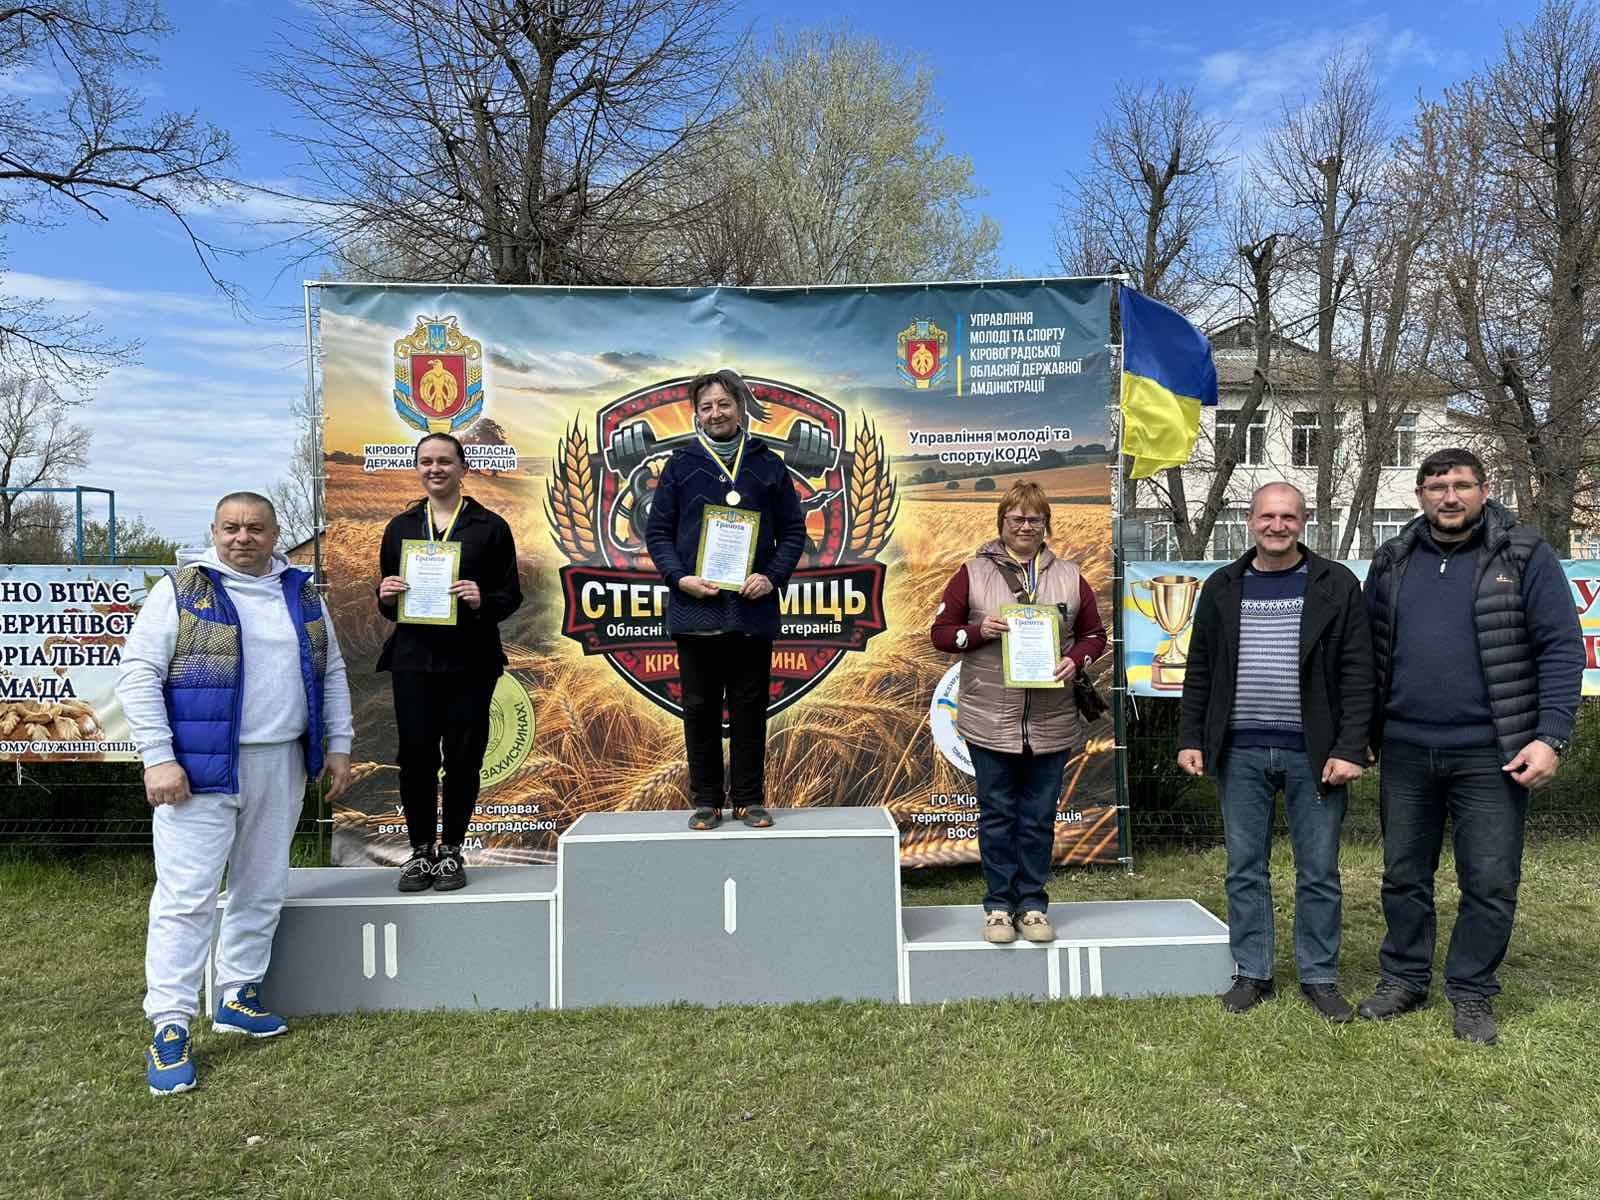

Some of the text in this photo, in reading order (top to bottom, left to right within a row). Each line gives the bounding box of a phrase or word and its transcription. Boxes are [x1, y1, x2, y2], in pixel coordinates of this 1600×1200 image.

[970, 312, 1033, 326] УПРАВЛІННЯ
[970, 327, 1065, 344] МОЛОДІ ТА СПОРТУ
[970, 342, 1061, 361] КІРОВОГРАДСЬКОЇ
[970, 358, 1082, 378] ОБЛАСНОЇ ДЕРЖАВНОЇ
[910, 427, 1070, 446] Управління молоді та
[365, 445, 516, 456] КІРОВОГР ОБЛАСНА
[940, 447, 1038, 464] спорту КОДА
[366, 458, 417, 470] ДЕРЖАВ
[49, 582, 130, 603] ВІТАЄ
[606, 622, 662, 637] Обласні
[781, 620, 842, 637] етеранів
[0, 646, 121, 666] РІАЛЬНА
[31, 742, 95, 752] СЛУЖІННІ
[931, 794, 948, 806] ГО
[486, 804, 540, 817] справах
[910, 810, 981, 825] територіал
[467, 818, 557, 834] овоградської
[947, 827, 979, 839] ВФС
